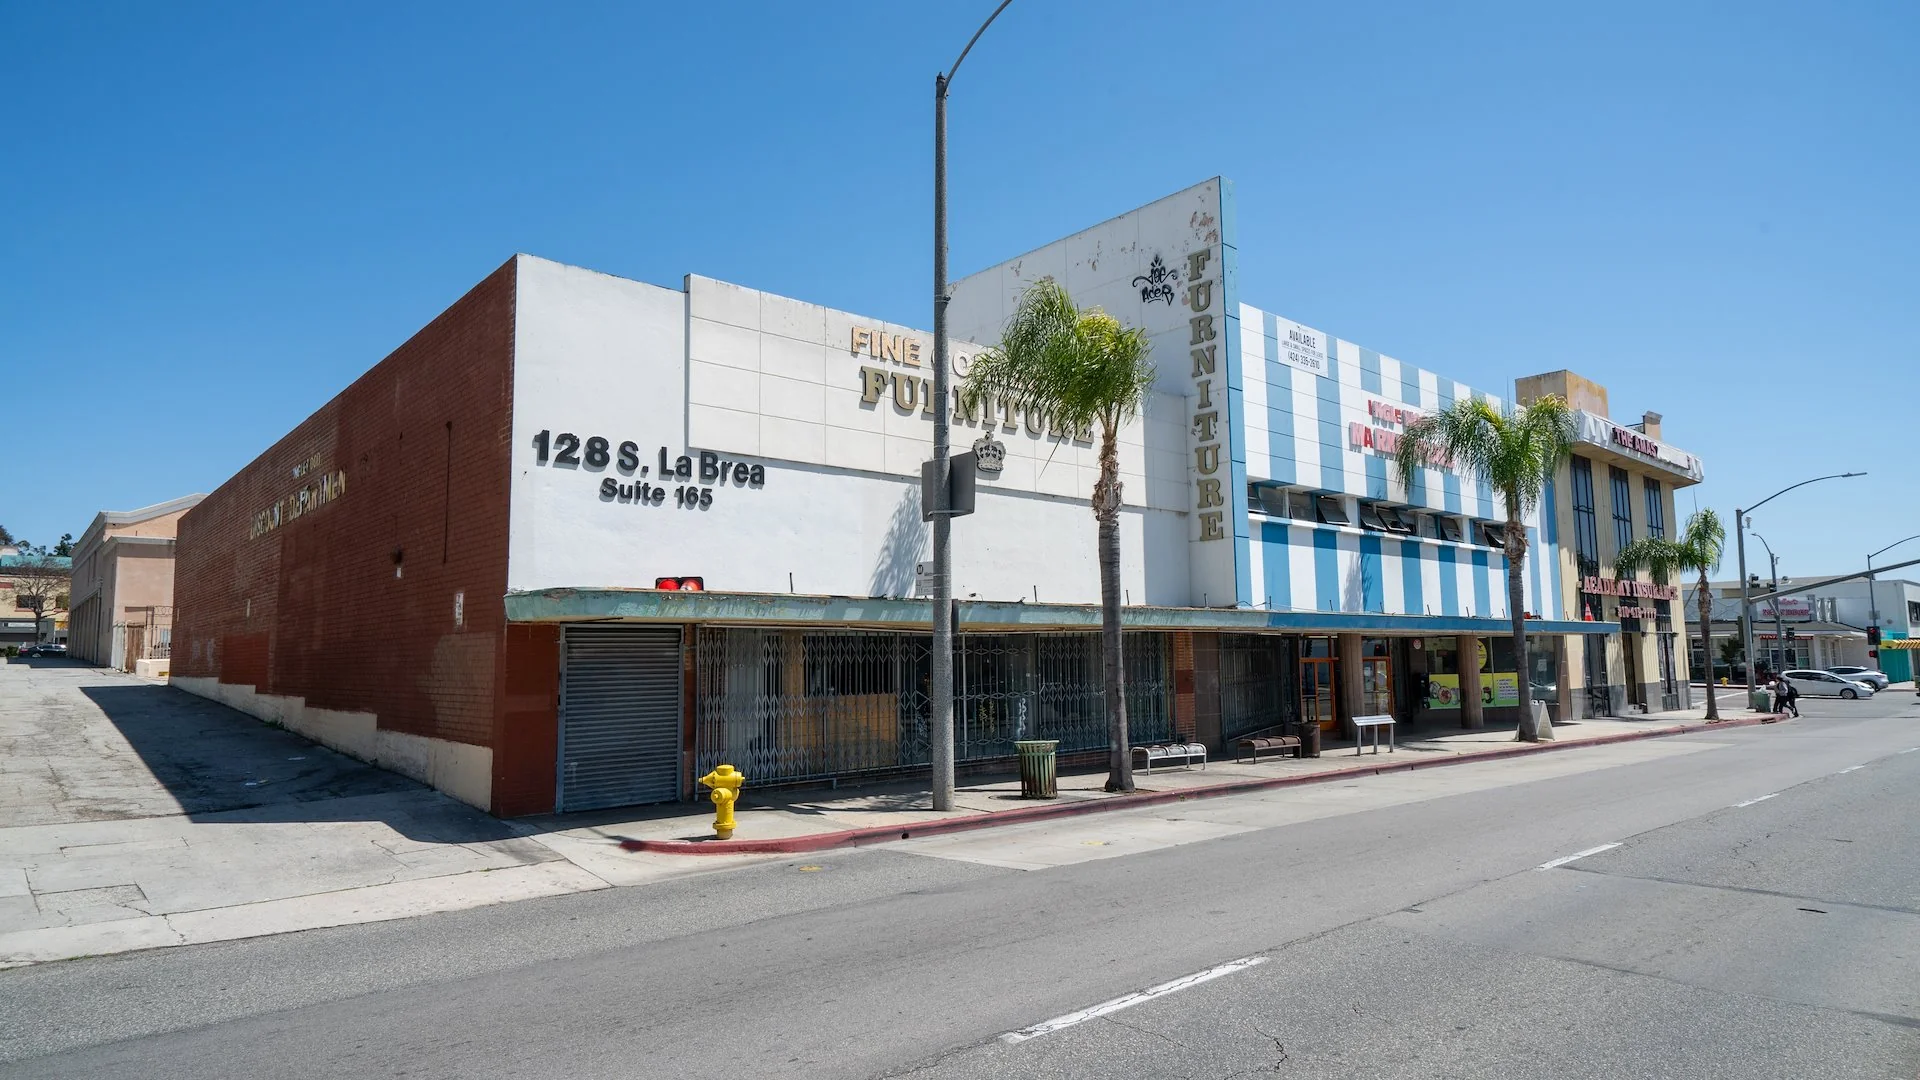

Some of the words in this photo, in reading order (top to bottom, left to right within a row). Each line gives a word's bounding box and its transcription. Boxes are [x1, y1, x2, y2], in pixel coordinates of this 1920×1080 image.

[851, 326, 921, 367] FINE
[1289, 329, 1316, 349] AVAILABLE
[1187, 248, 1224, 541] FURNITURE
[1613, 427, 1633, 448] THE
[533, 429, 611, 469] 128
[617, 440, 650, 475] S.
[659, 446, 692, 479] La
[699, 450, 765, 487] Brea
[600, 477, 666, 506] Suite
[675, 484, 714, 510] 165
[1583, 575, 1631, 596] ACADEMY
[1632, 581, 1679, 601] INSURANCE
